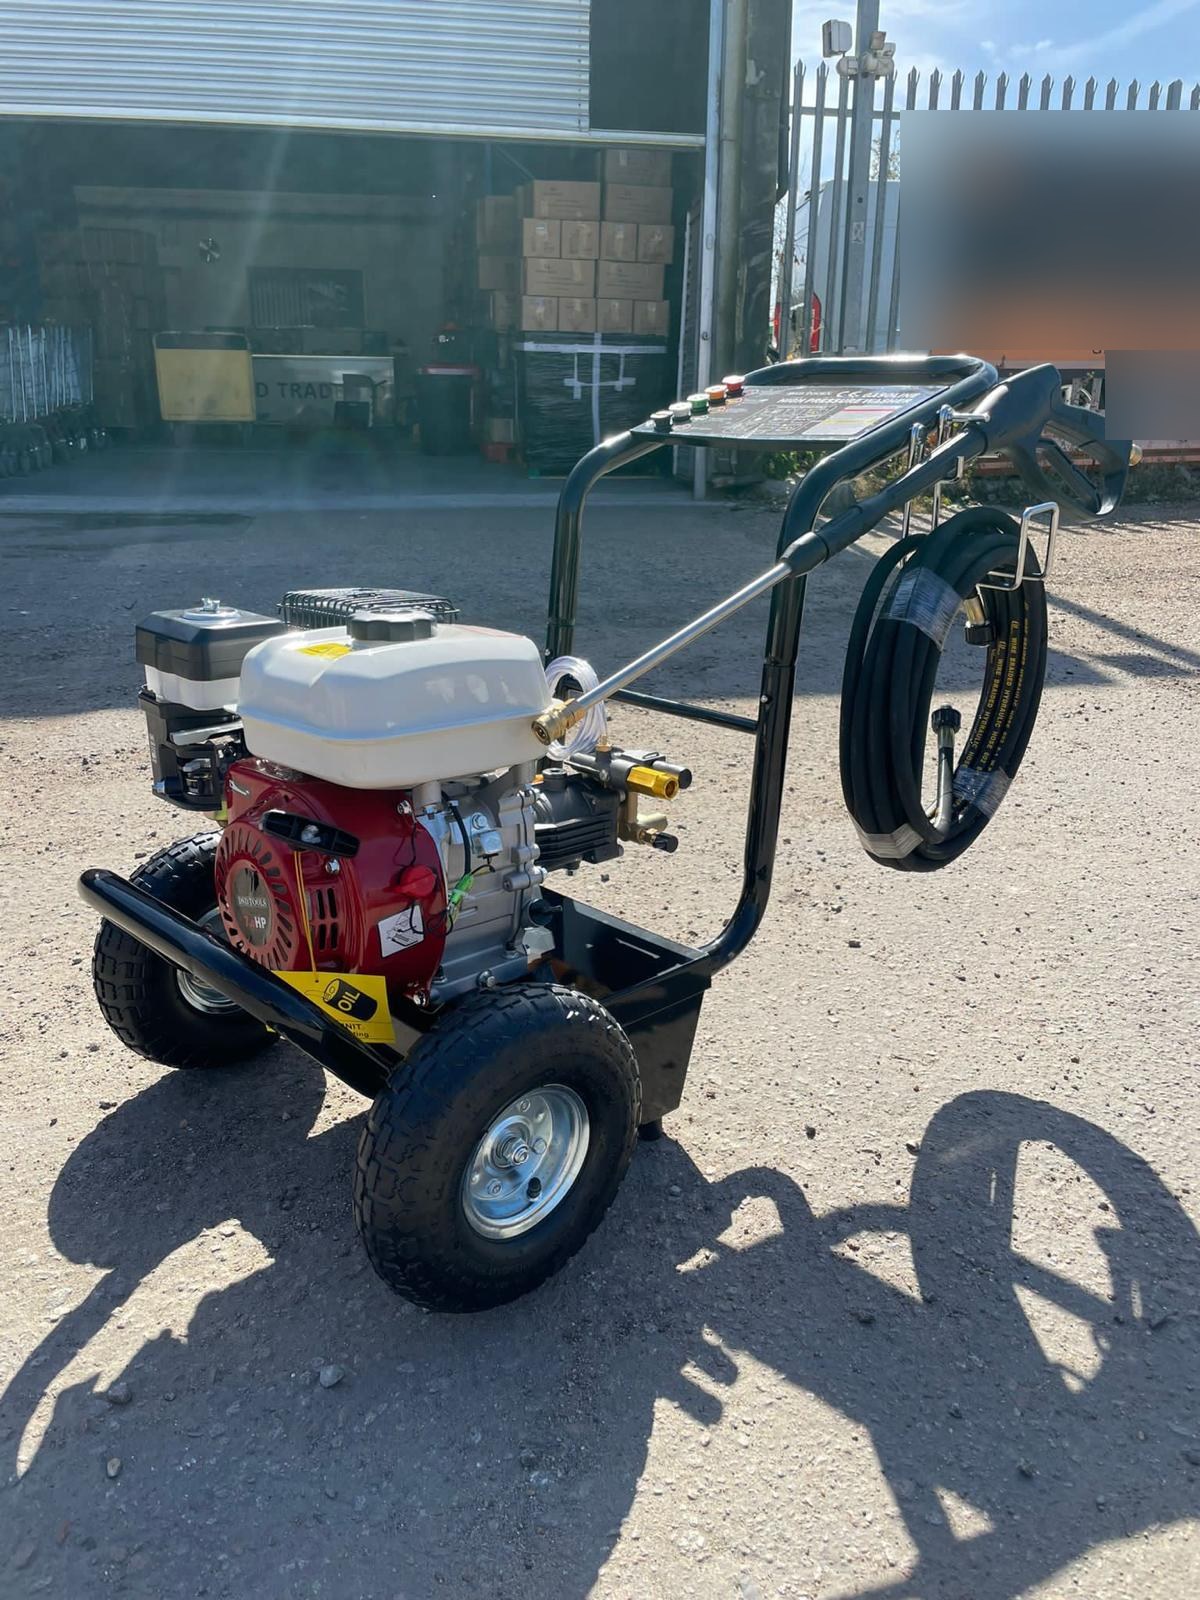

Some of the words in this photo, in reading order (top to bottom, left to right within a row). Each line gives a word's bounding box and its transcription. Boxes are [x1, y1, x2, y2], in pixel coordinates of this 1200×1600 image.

[1006, 657, 1017, 687] BRAIDED
[987, 678, 1001, 709] BRAIDED
[995, 689, 1011, 728] HYDRAULIC
[972, 711, 991, 749] HYDRAULIC
[987, 731, 1000, 749] HOSE
[337, 991, 361, 1012] OIL
